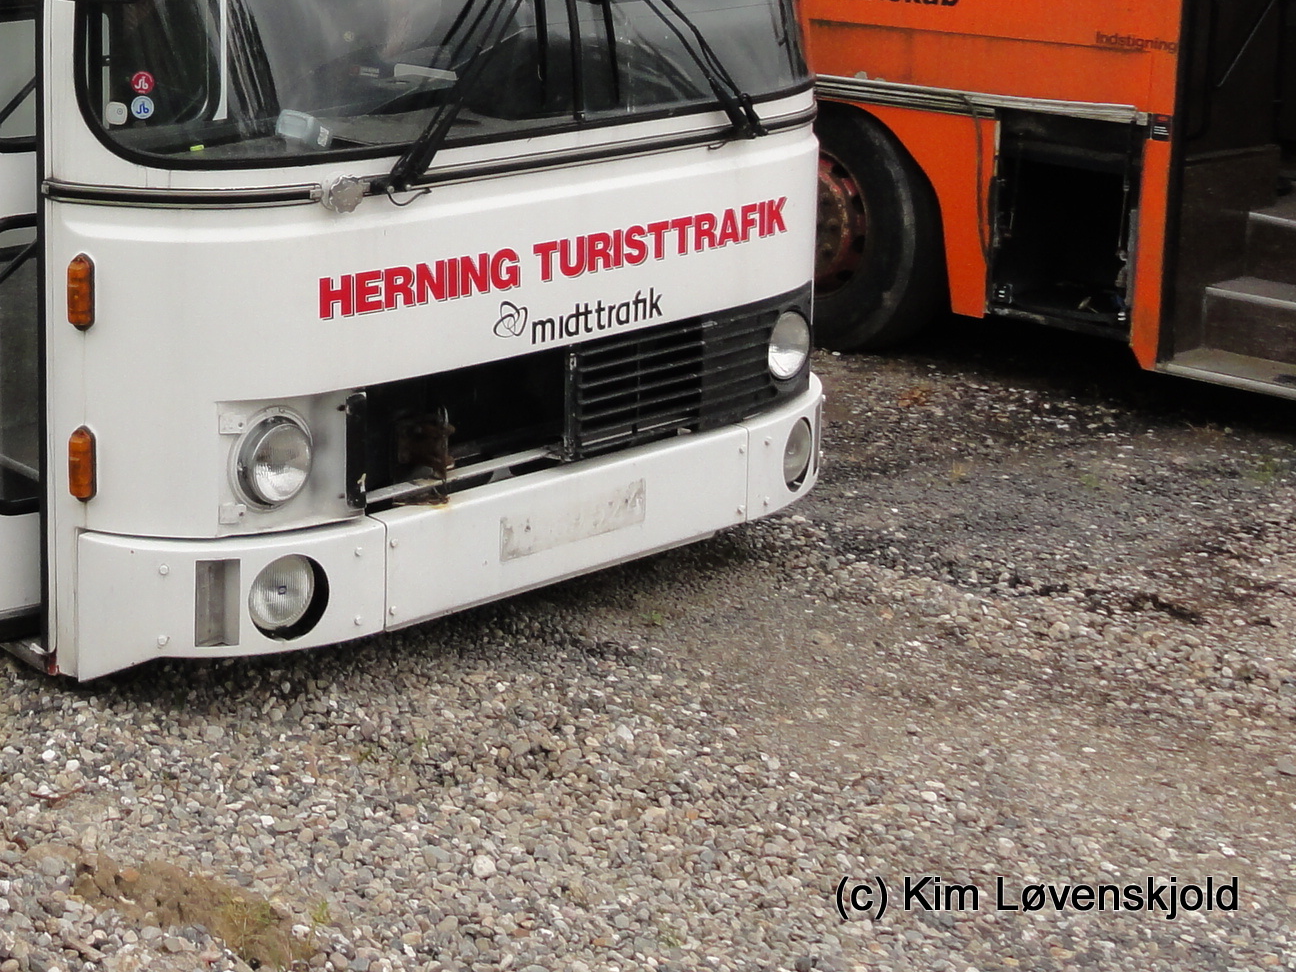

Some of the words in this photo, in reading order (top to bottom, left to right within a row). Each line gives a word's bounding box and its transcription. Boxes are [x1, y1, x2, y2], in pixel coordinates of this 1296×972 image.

[1095, 31, 1177, 54] Indstigning
[319, 248, 521, 320] HERNING
[533, 196, 788, 281] TURISTTRAFIK
[530, 287, 664, 345] midttrafik
